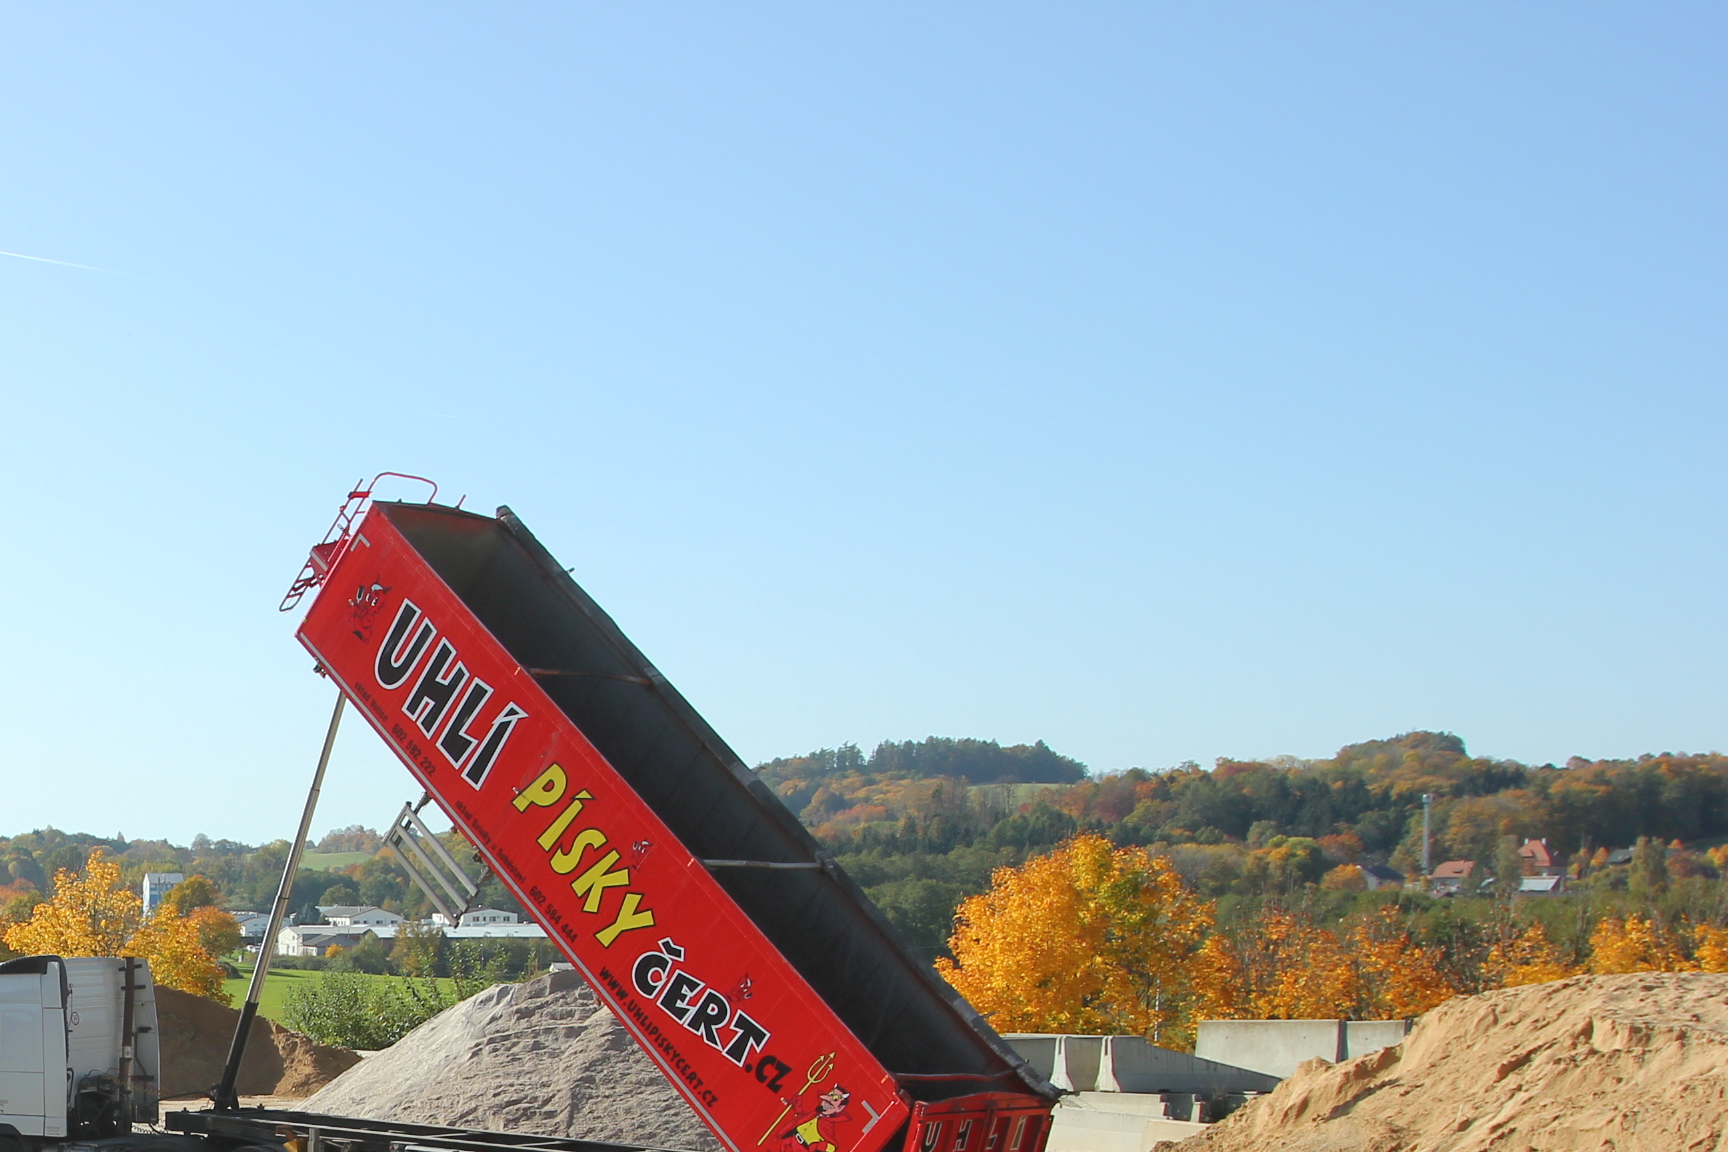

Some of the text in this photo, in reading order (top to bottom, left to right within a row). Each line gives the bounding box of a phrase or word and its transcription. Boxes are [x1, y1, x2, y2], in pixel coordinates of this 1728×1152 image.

[375, 598, 529, 791] UHLÍ
[391, 723, 407, 743] 602
[406, 741, 422, 760] 582
[420, 756, 436, 775] 222
[511, 763, 655, 949] PÍSKY
[529, 885, 546, 906] 602
[545, 903, 562, 925] 584
[561, 923, 578, 943] 444
